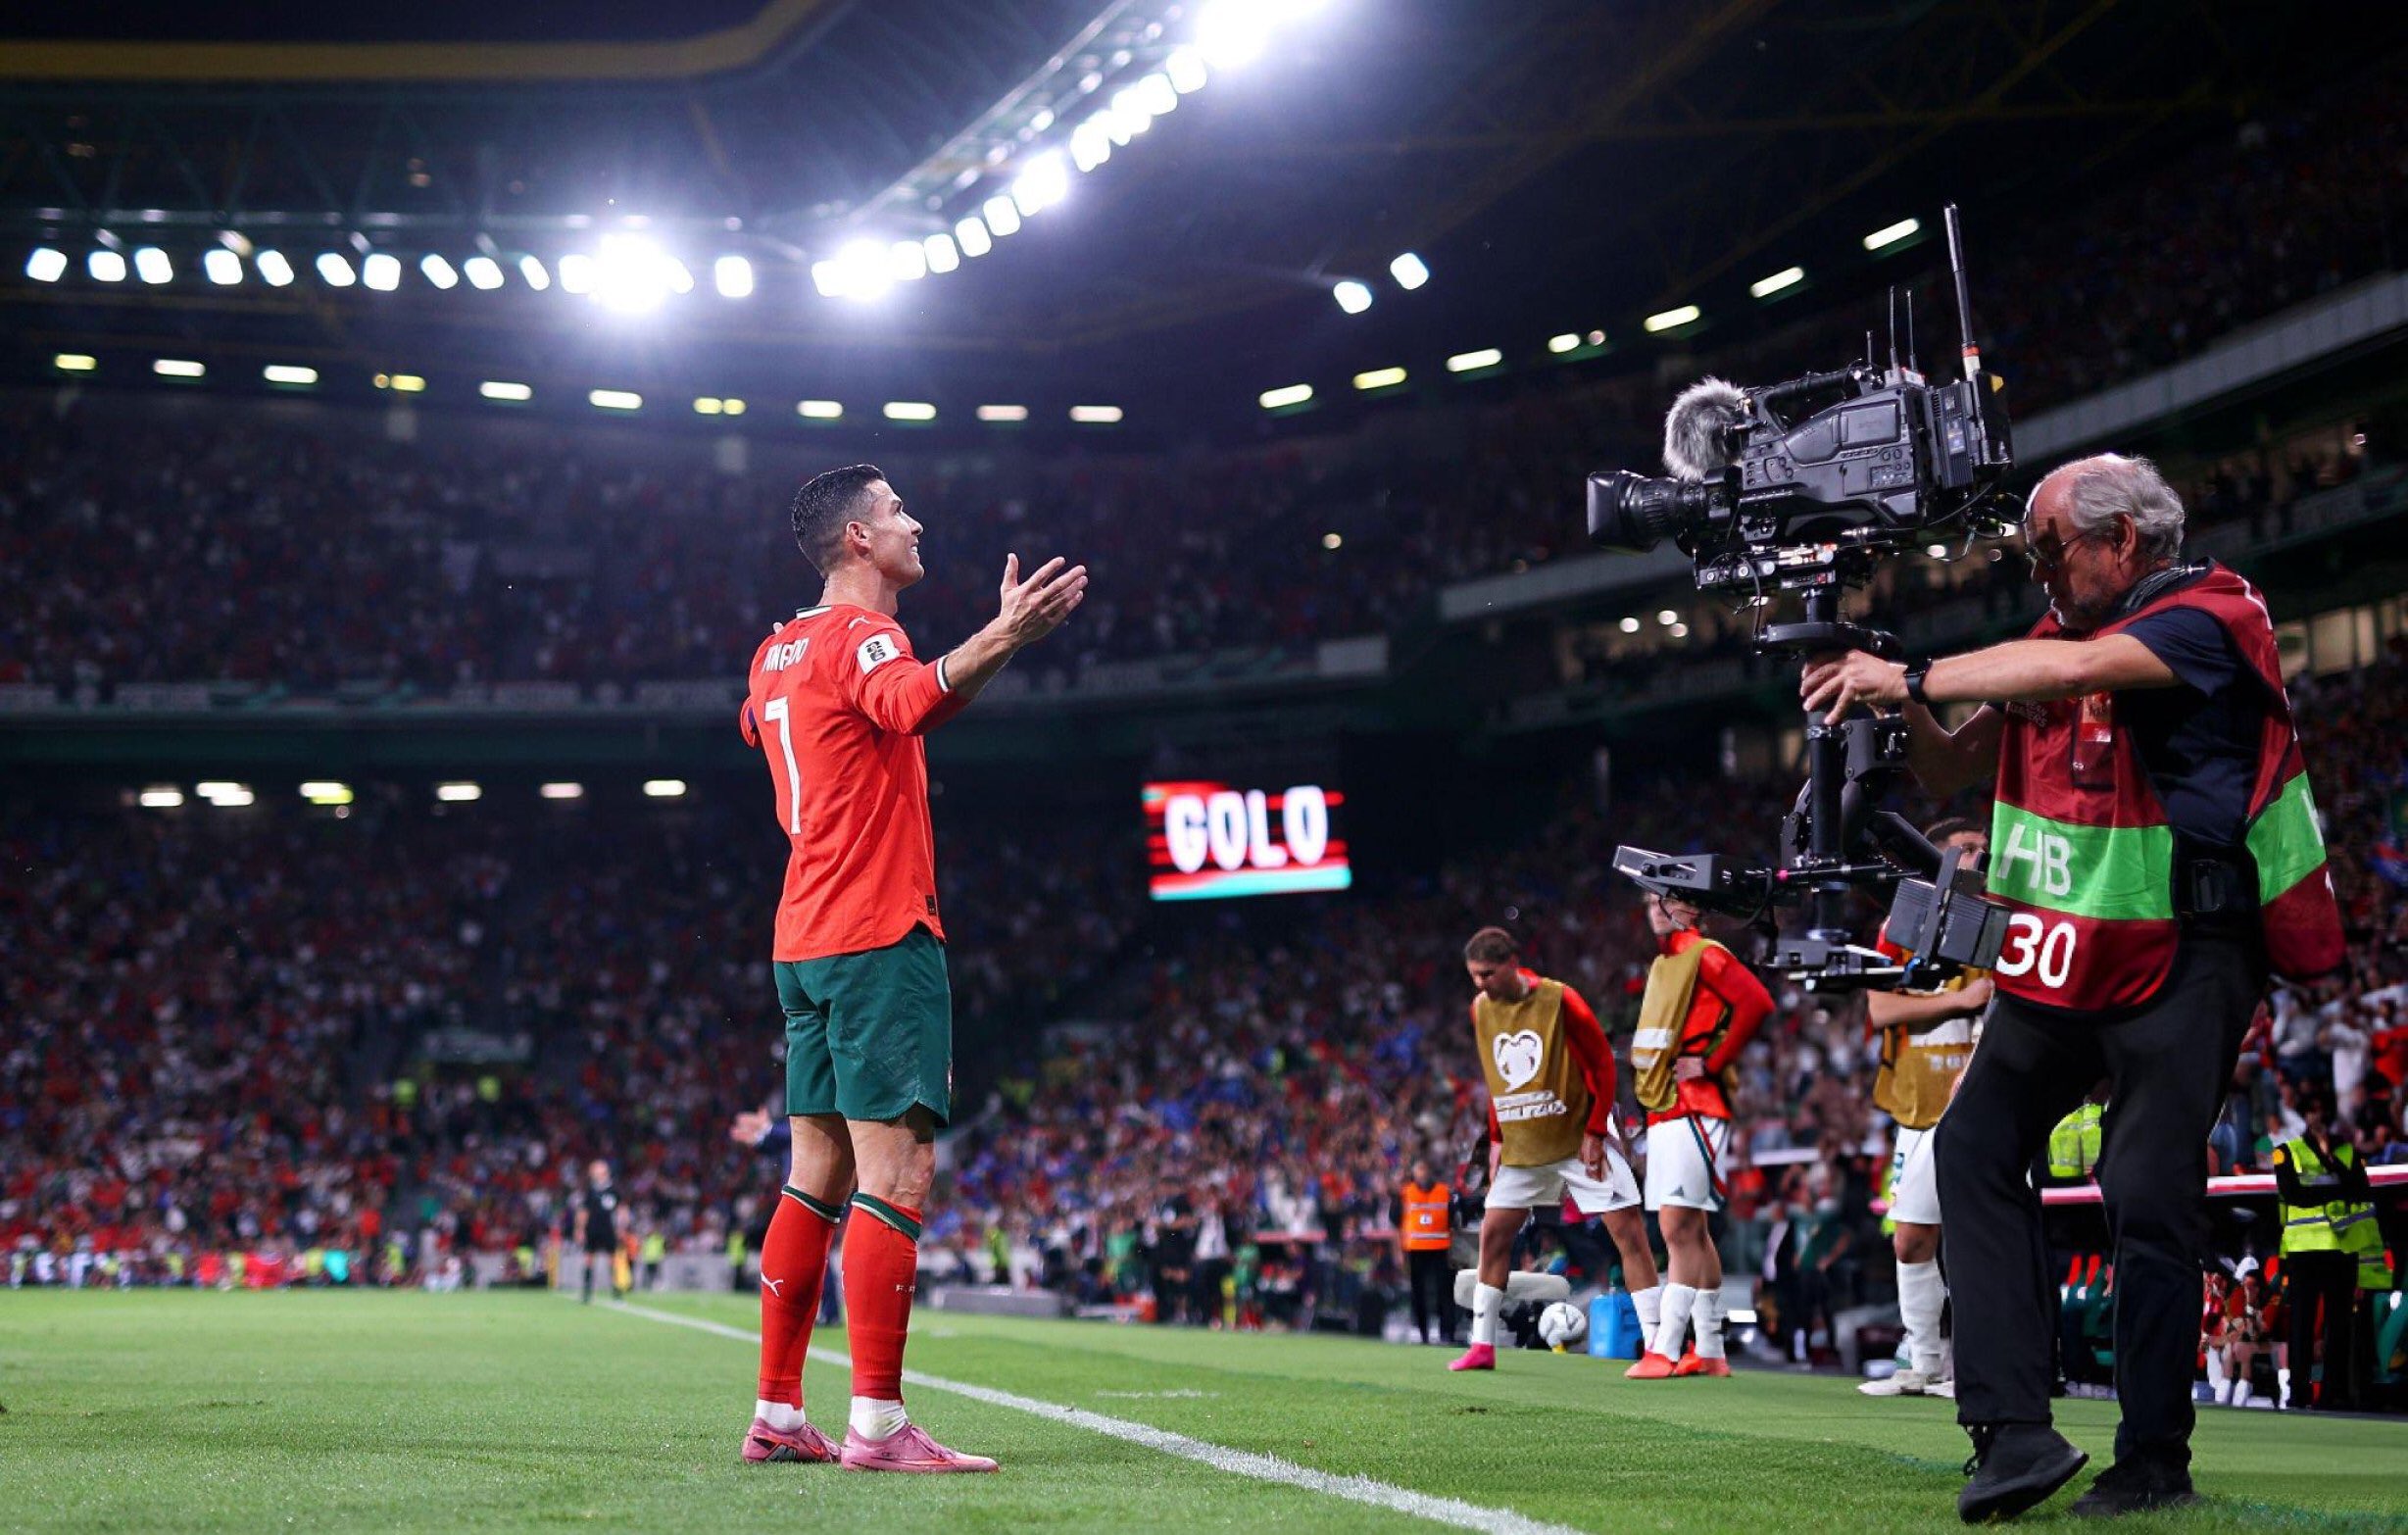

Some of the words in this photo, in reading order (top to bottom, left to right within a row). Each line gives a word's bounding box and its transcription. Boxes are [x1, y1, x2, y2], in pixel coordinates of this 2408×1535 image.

[763, 697, 802, 835] 7
[1165, 785, 1328, 873] GOLO
[1996, 823, 2071, 896] HB
[1995, 913, 2077, 989] 30
